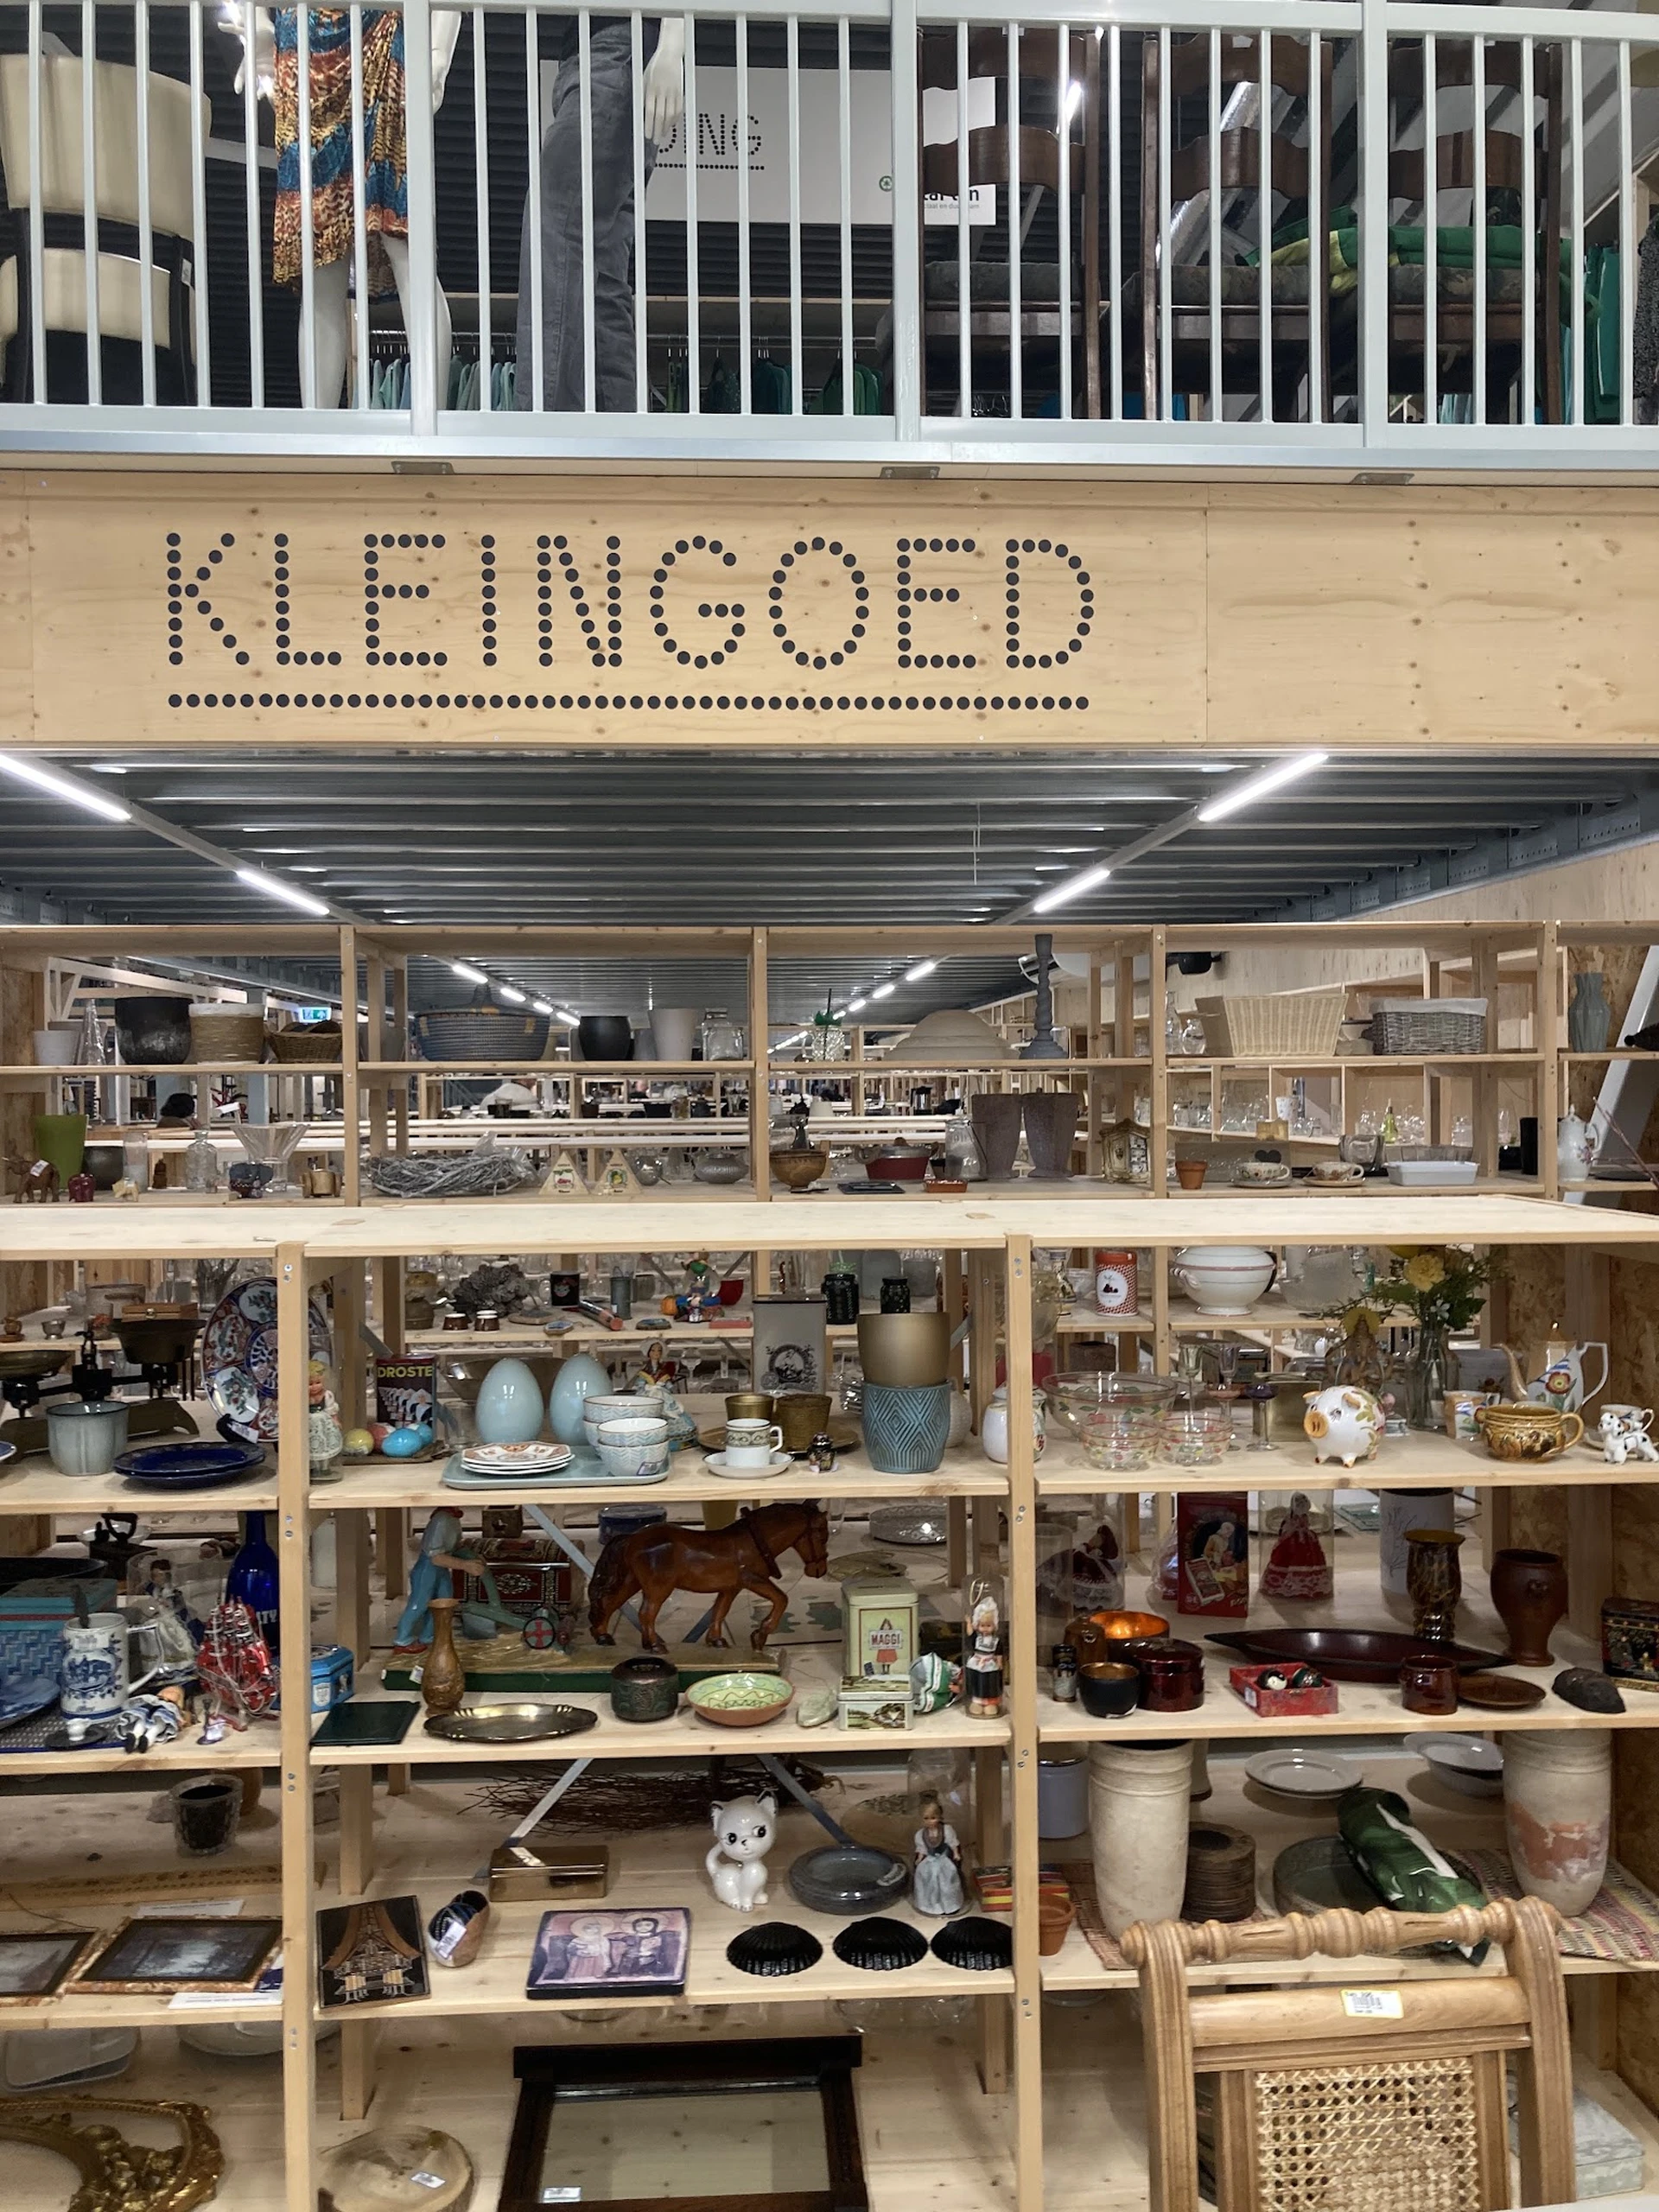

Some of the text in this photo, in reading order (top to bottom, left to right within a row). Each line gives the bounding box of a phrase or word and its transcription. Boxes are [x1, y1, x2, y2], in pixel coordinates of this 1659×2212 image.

[167, 532, 1094, 670] KLEINGOED
[378, 1366, 434, 1378] DROSTE
[871, 1633, 900, 1646] MAGGI
